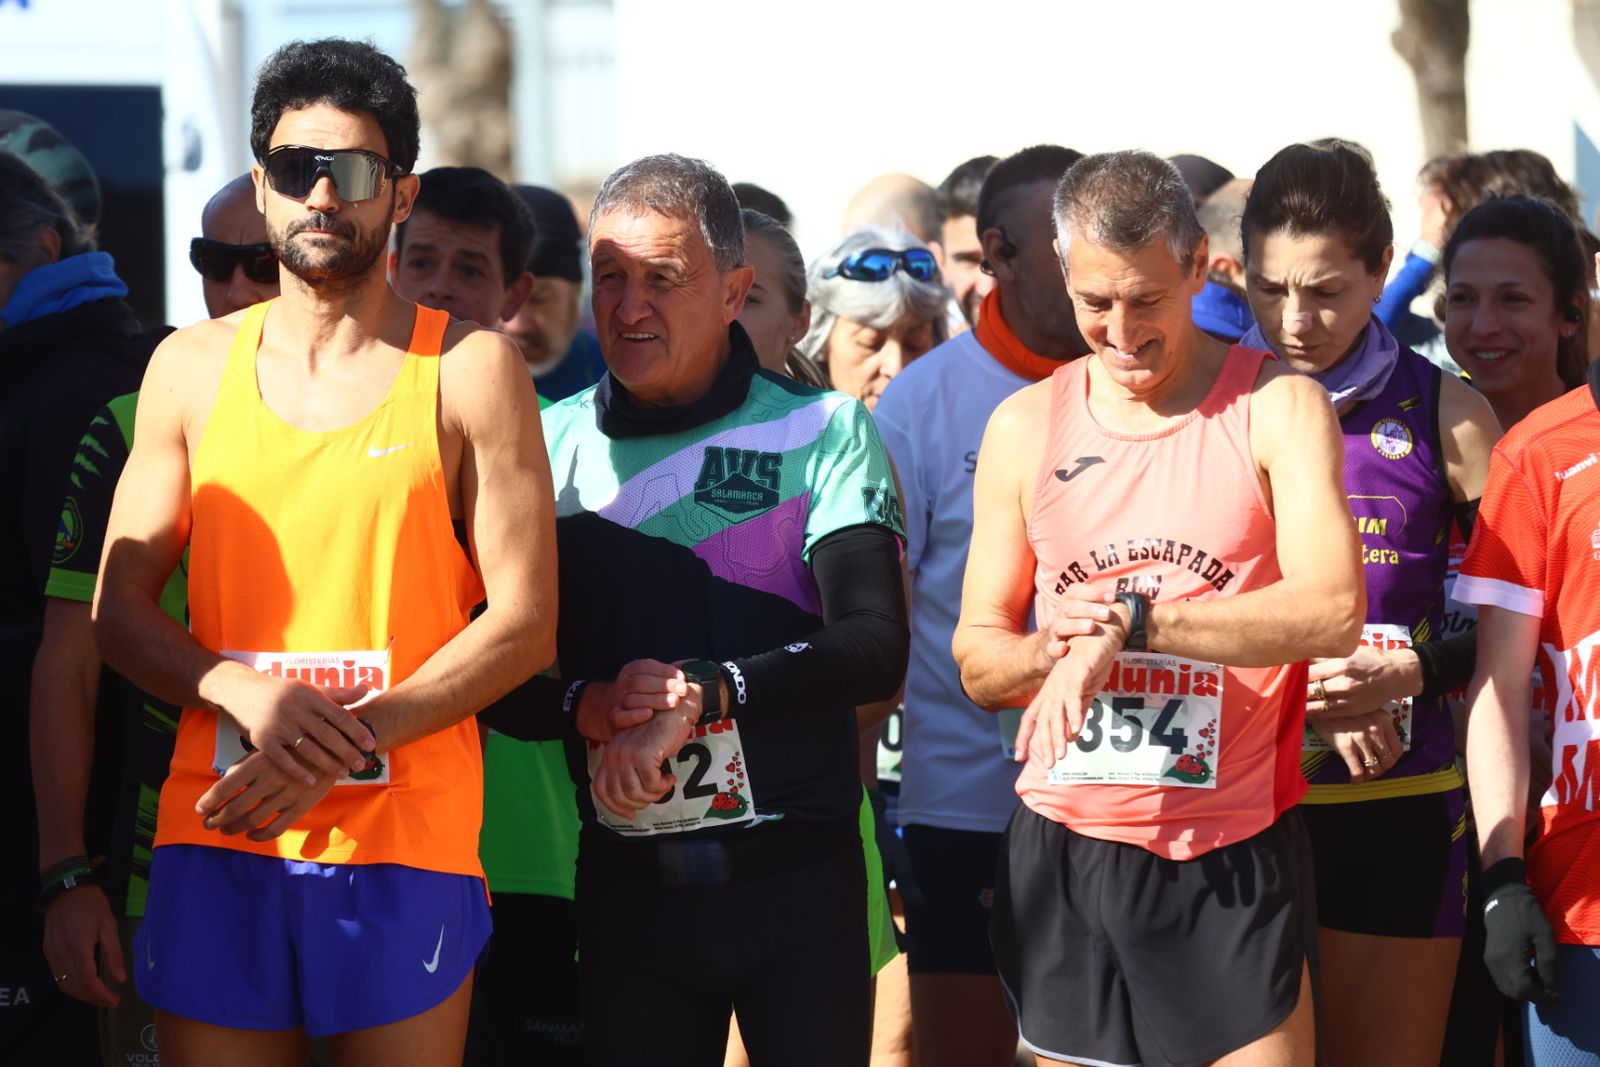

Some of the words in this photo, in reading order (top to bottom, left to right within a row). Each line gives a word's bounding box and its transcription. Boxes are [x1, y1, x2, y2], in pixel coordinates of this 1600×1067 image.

[1354, 516, 1387, 536] IM
[1090, 543, 1120, 572] LA
[1127, 538, 1235, 593] ESCAPADA
[1075, 696, 1188, 756] 354
